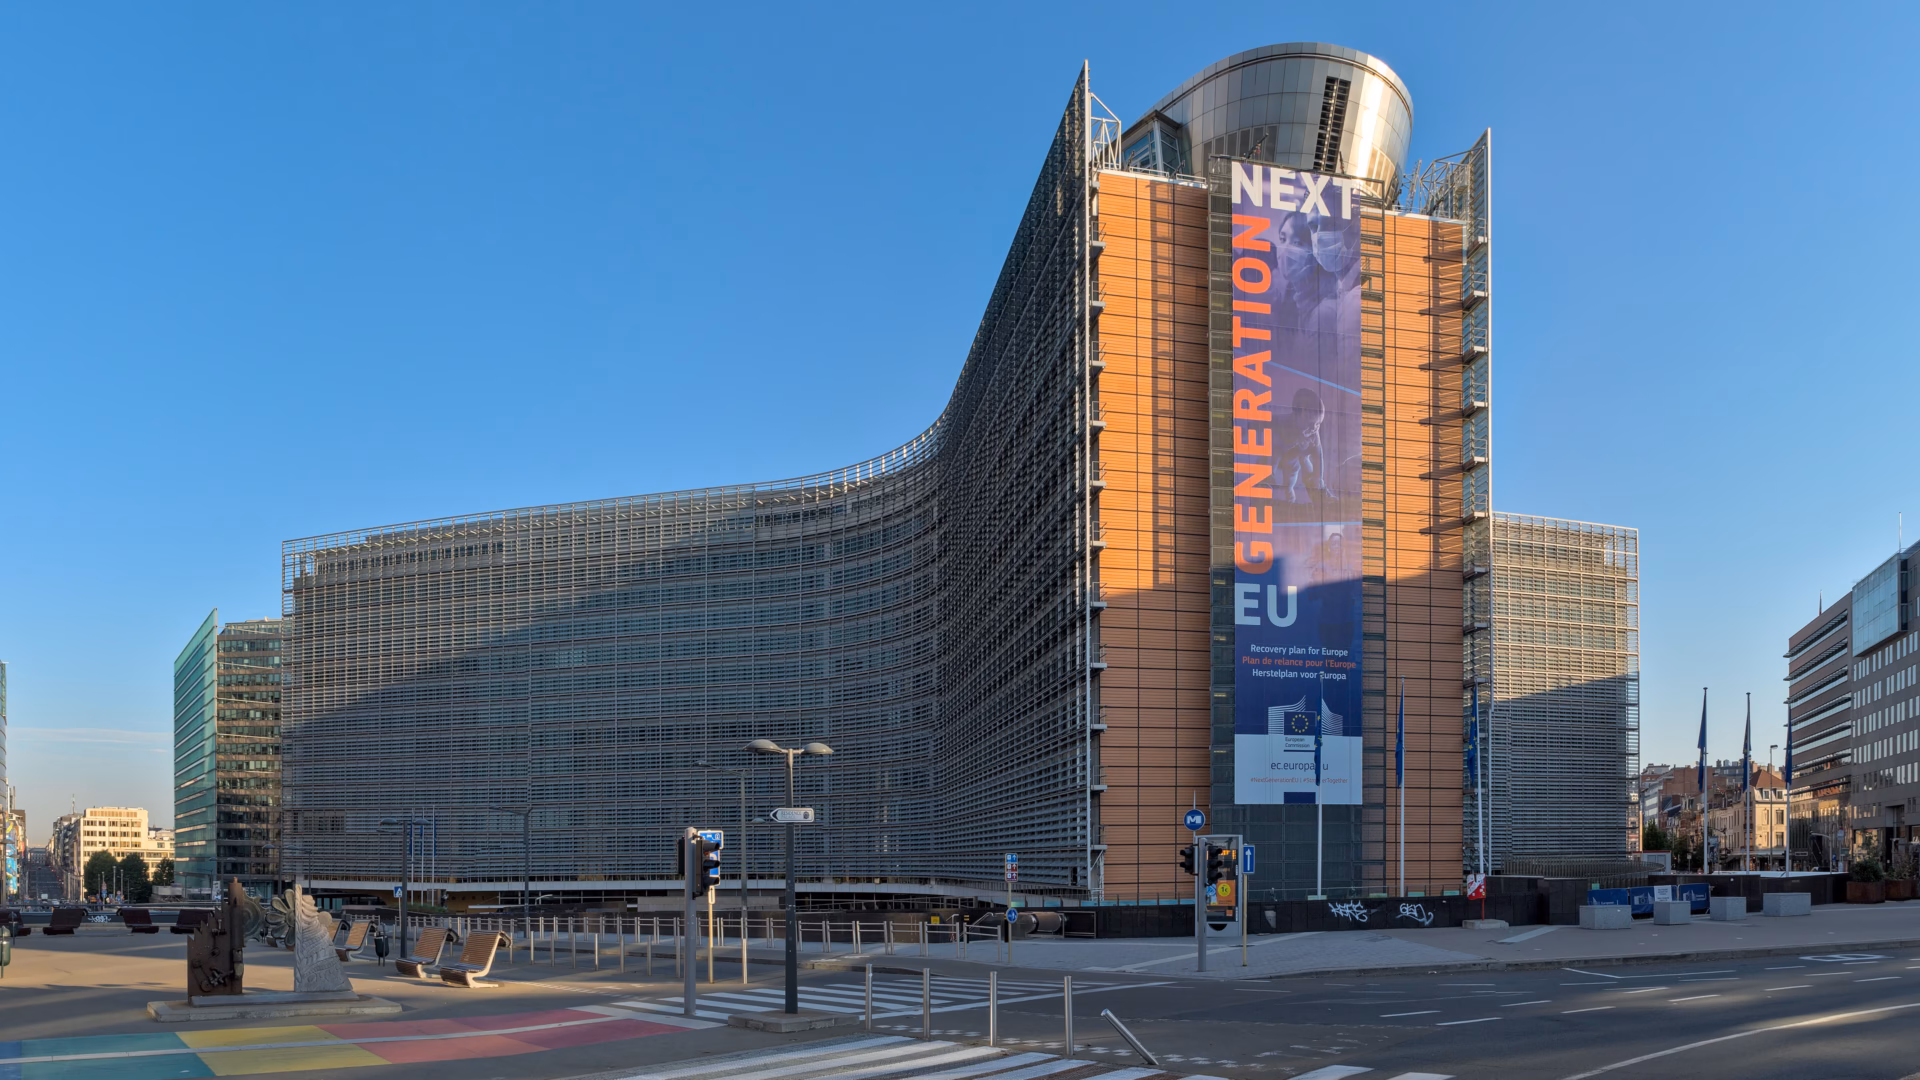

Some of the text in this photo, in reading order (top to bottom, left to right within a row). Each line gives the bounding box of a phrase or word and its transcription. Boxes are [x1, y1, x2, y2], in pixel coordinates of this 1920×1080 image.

[1231, 161, 1356, 220] NEXT
[1231, 214, 1273, 574] GENERATION
[1234, 583, 1297, 628] EU
[1250, 644, 1348, 657] Recovery plan for Europe
[1242, 656, 1356, 670] Plan de relance pour l'Europe
[1252, 669, 1298, 679] Herstelplan
[1300, 671, 1317, 679] voor
[1270, 762, 1329, 772] ec.europau
